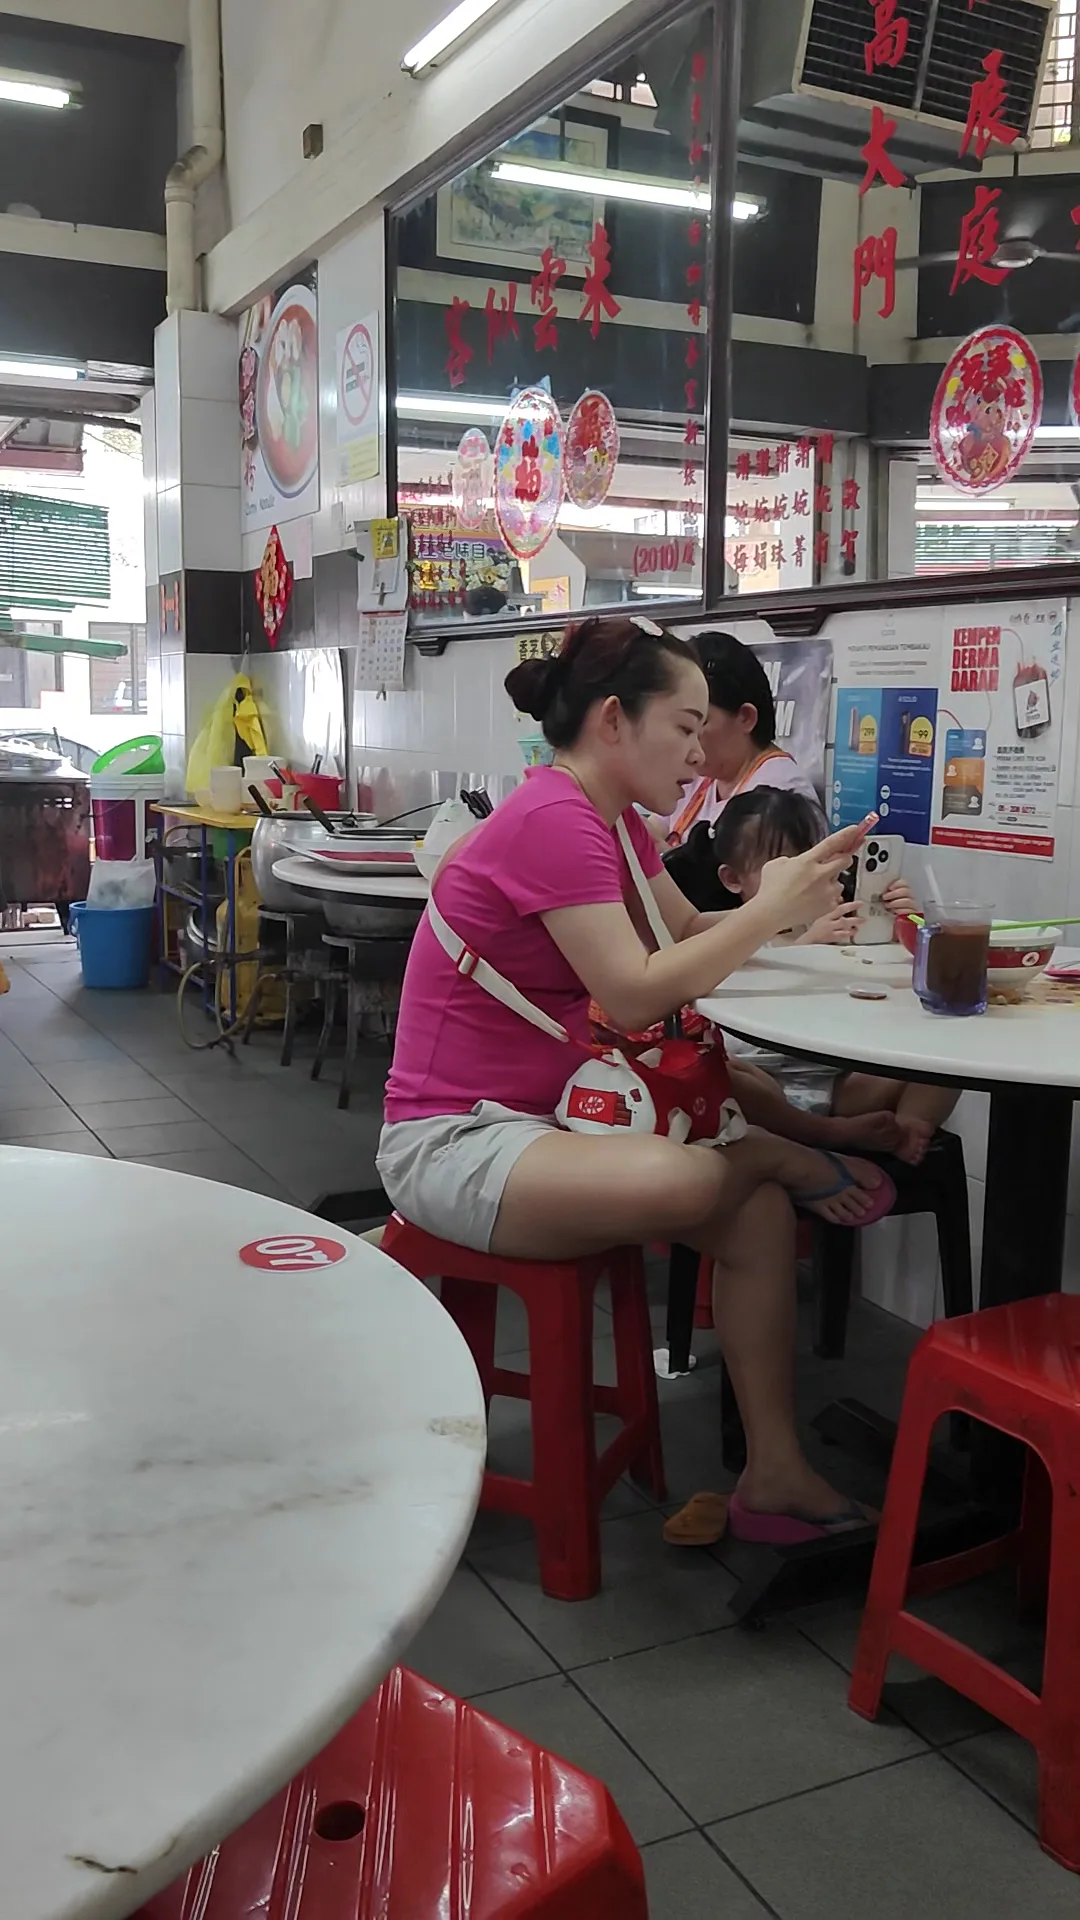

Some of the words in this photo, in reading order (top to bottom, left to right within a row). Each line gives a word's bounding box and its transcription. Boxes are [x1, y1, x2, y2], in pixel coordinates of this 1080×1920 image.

[633, 539, 680, 577] (2010)
[953, 626, 1001, 647] KEMPEN
[952, 647, 1000, 669] DERMA
[951, 669, 999, 692] DARAH
[256, 1239, 333, 1266] 10
